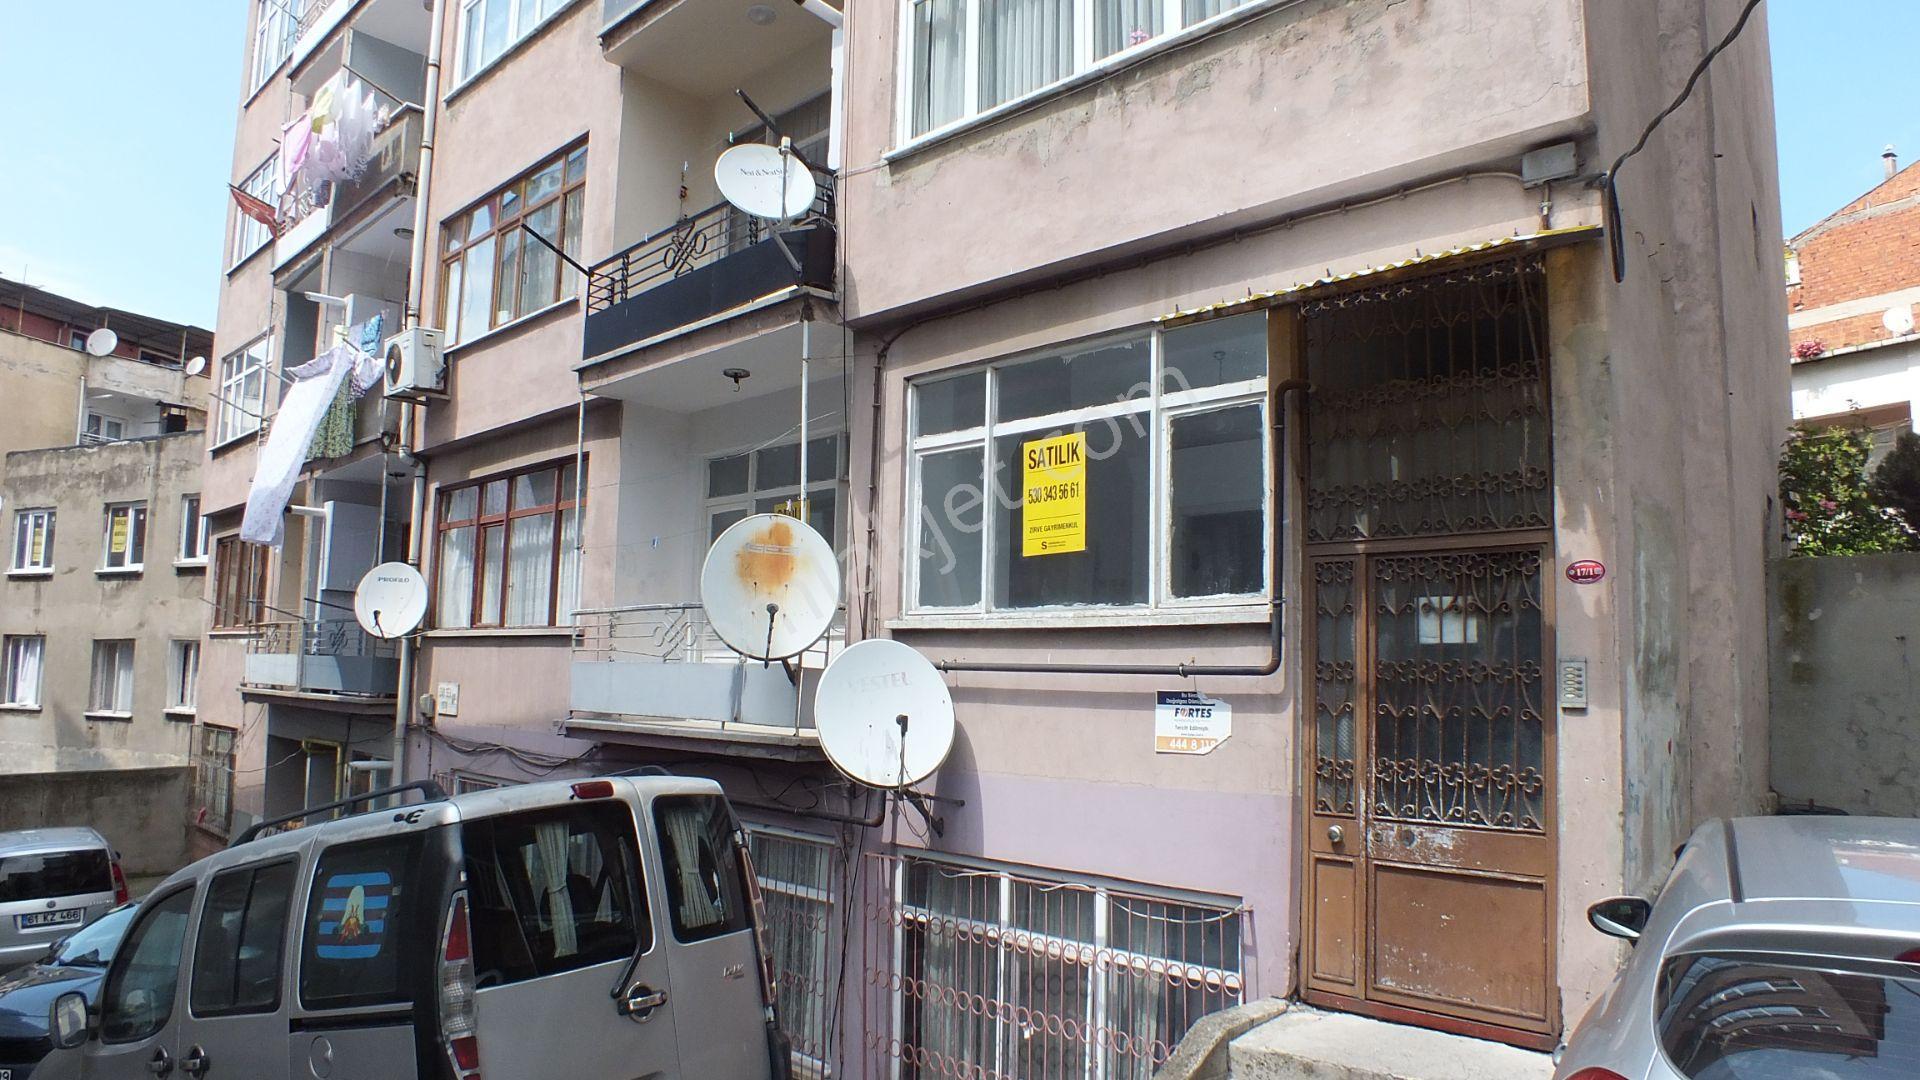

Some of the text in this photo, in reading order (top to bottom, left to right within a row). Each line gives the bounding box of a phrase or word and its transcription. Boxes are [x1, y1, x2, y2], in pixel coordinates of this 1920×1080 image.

[1028, 441, 1080, 470] SATILIK
[1028, 481, 1080, 504] 530 343 56 61
[1174, 707, 1212, 718] FORTES
[1168, 737, 1188, 750] 444
